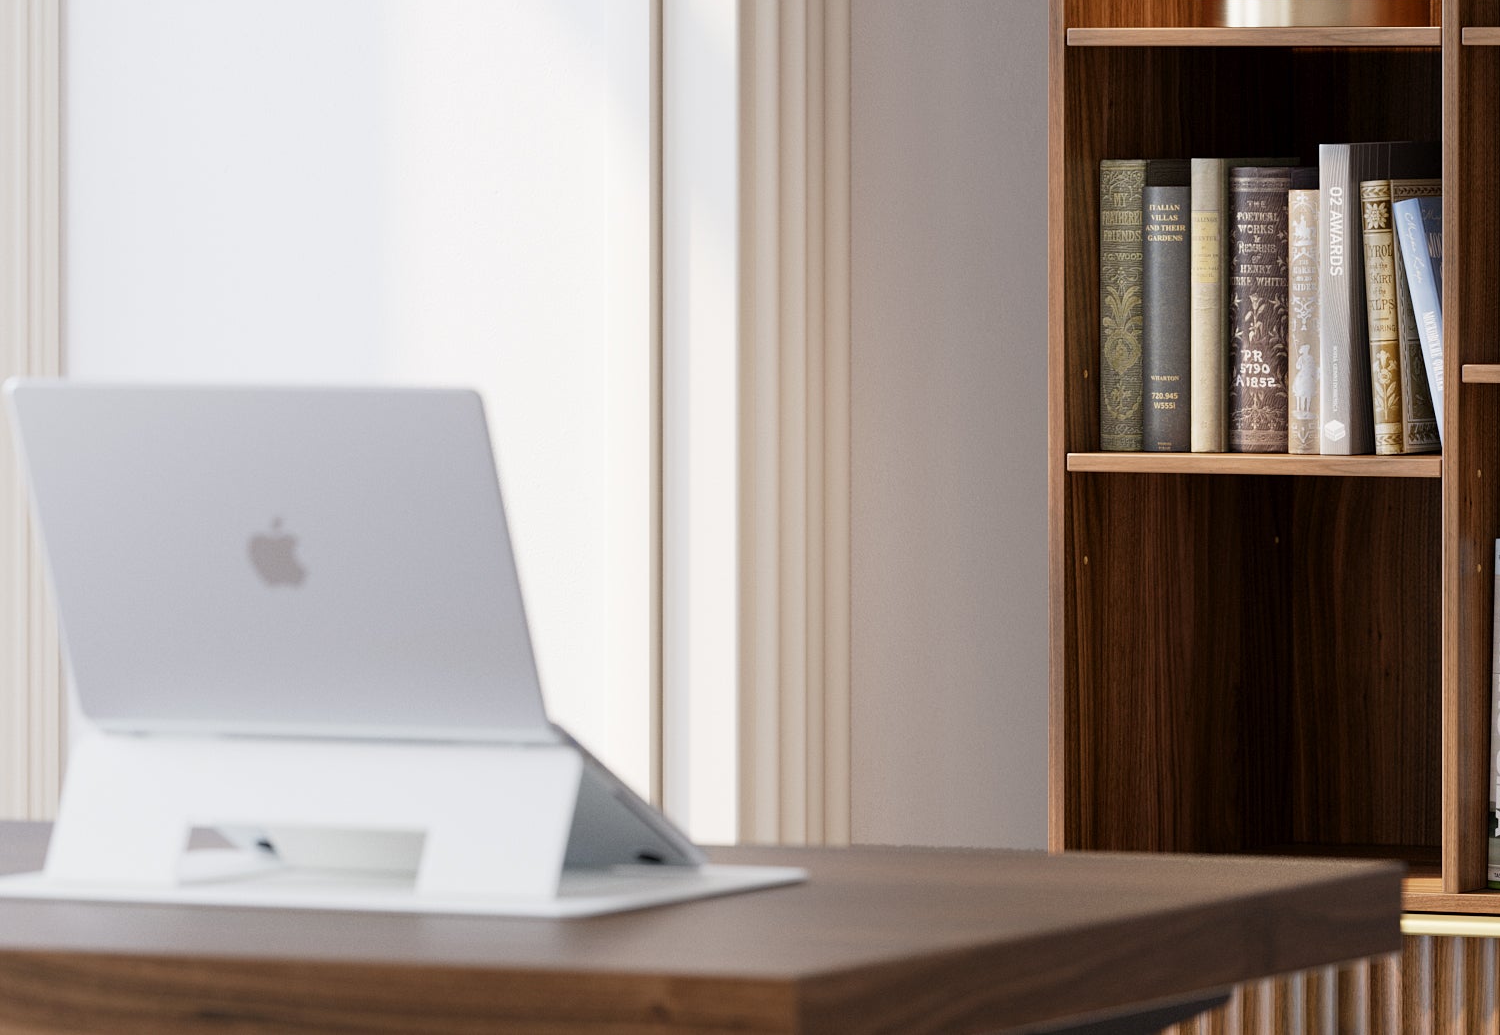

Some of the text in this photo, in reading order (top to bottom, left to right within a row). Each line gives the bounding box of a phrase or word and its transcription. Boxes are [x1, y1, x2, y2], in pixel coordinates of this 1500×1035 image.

[1113, 193, 1127, 207] MY
[1247, 200, 1267, 208] THE
[1150, 214, 1179, 222] VILLAS
[1236, 211, 1280, 222] POETICAL
[1145, 224, 1186, 232] AND THEIR
[1237, 224, 1275, 234] WORKS
[1147, 234, 1184, 242] GARDENS
[1329, 211, 1344, 276] AWARDS
[1240, 264, 1272, 274] HENRY
[1240, 349, 1264, 363] PR
[1239, 363, 1271, 374] 5790
[1151, 392, 1179, 400] 720.945
